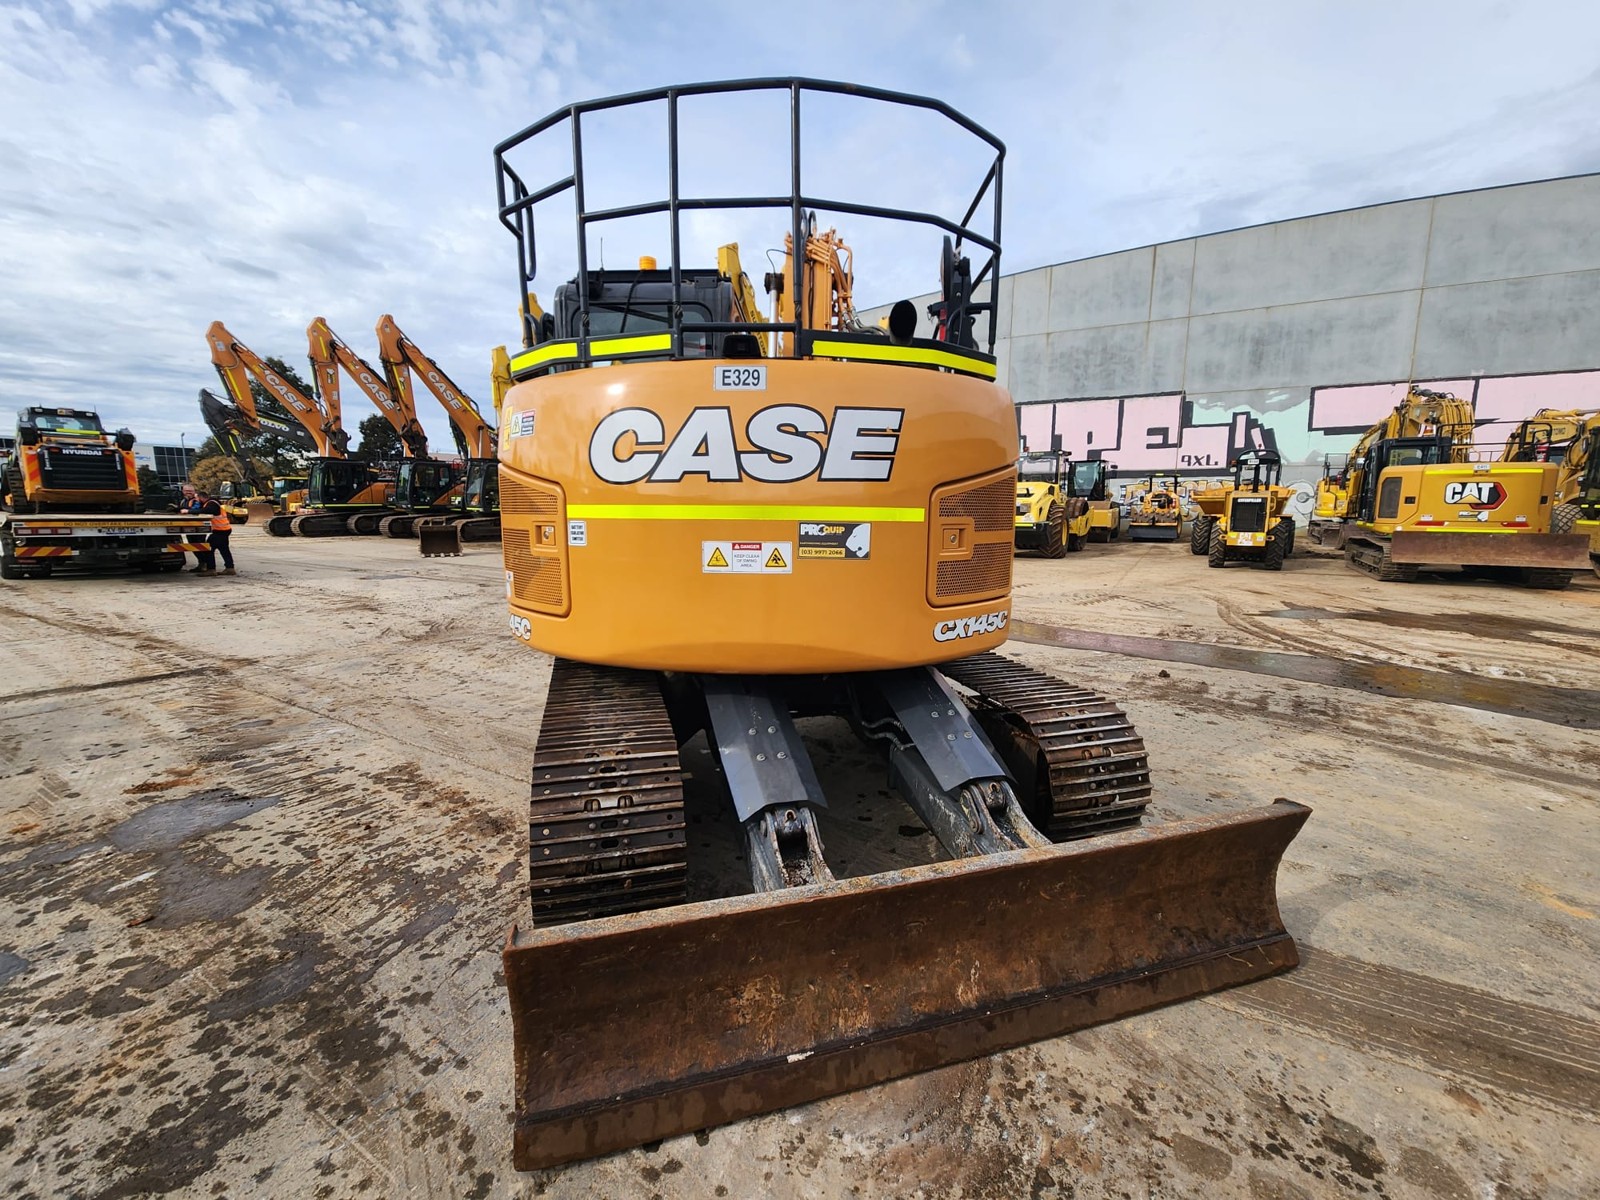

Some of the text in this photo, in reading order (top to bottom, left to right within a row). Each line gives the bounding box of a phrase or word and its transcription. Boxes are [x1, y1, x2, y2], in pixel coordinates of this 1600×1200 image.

[265, 373, 307, 412] CASE
[360, 372, 395, 411] CASE
[427, 371, 462, 410] CASE
[721, 368, 761, 387] E329
[62, 448, 102, 456] HYUNDAI
[588, 403, 905, 485] CASE
[1444, 482, 1495, 504] CAT
[932, 610, 1008, 642] CX145C
